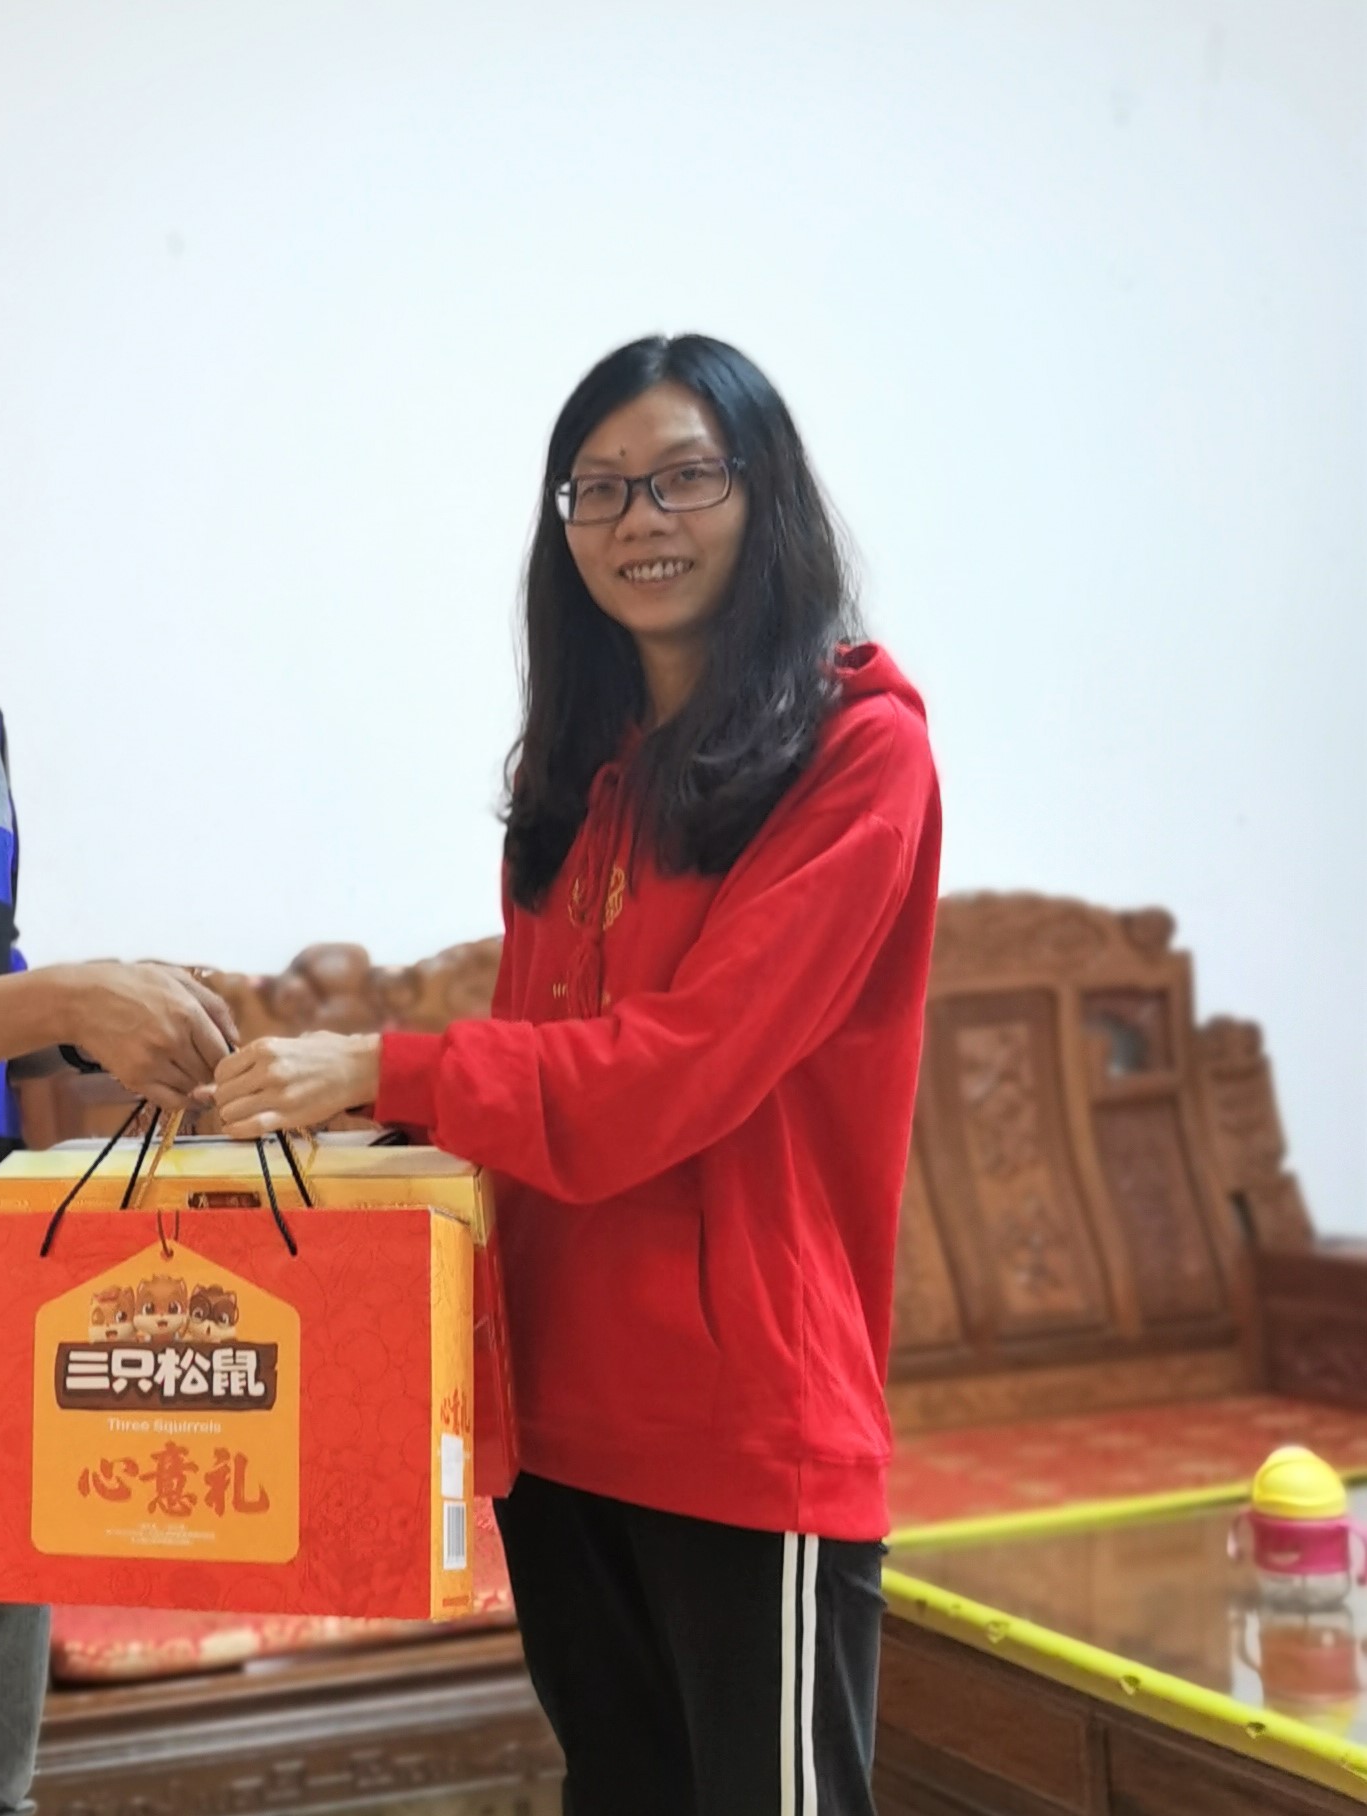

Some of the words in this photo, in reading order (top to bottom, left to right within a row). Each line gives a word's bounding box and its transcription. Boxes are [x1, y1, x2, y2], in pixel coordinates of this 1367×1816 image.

[65, 1347, 266, 1397] 三只松鼠
[107, 1417, 150, 1432] Three
[153, 1418, 222, 1434] Squirrels
[78, 1440, 270, 1518] 心意礼
